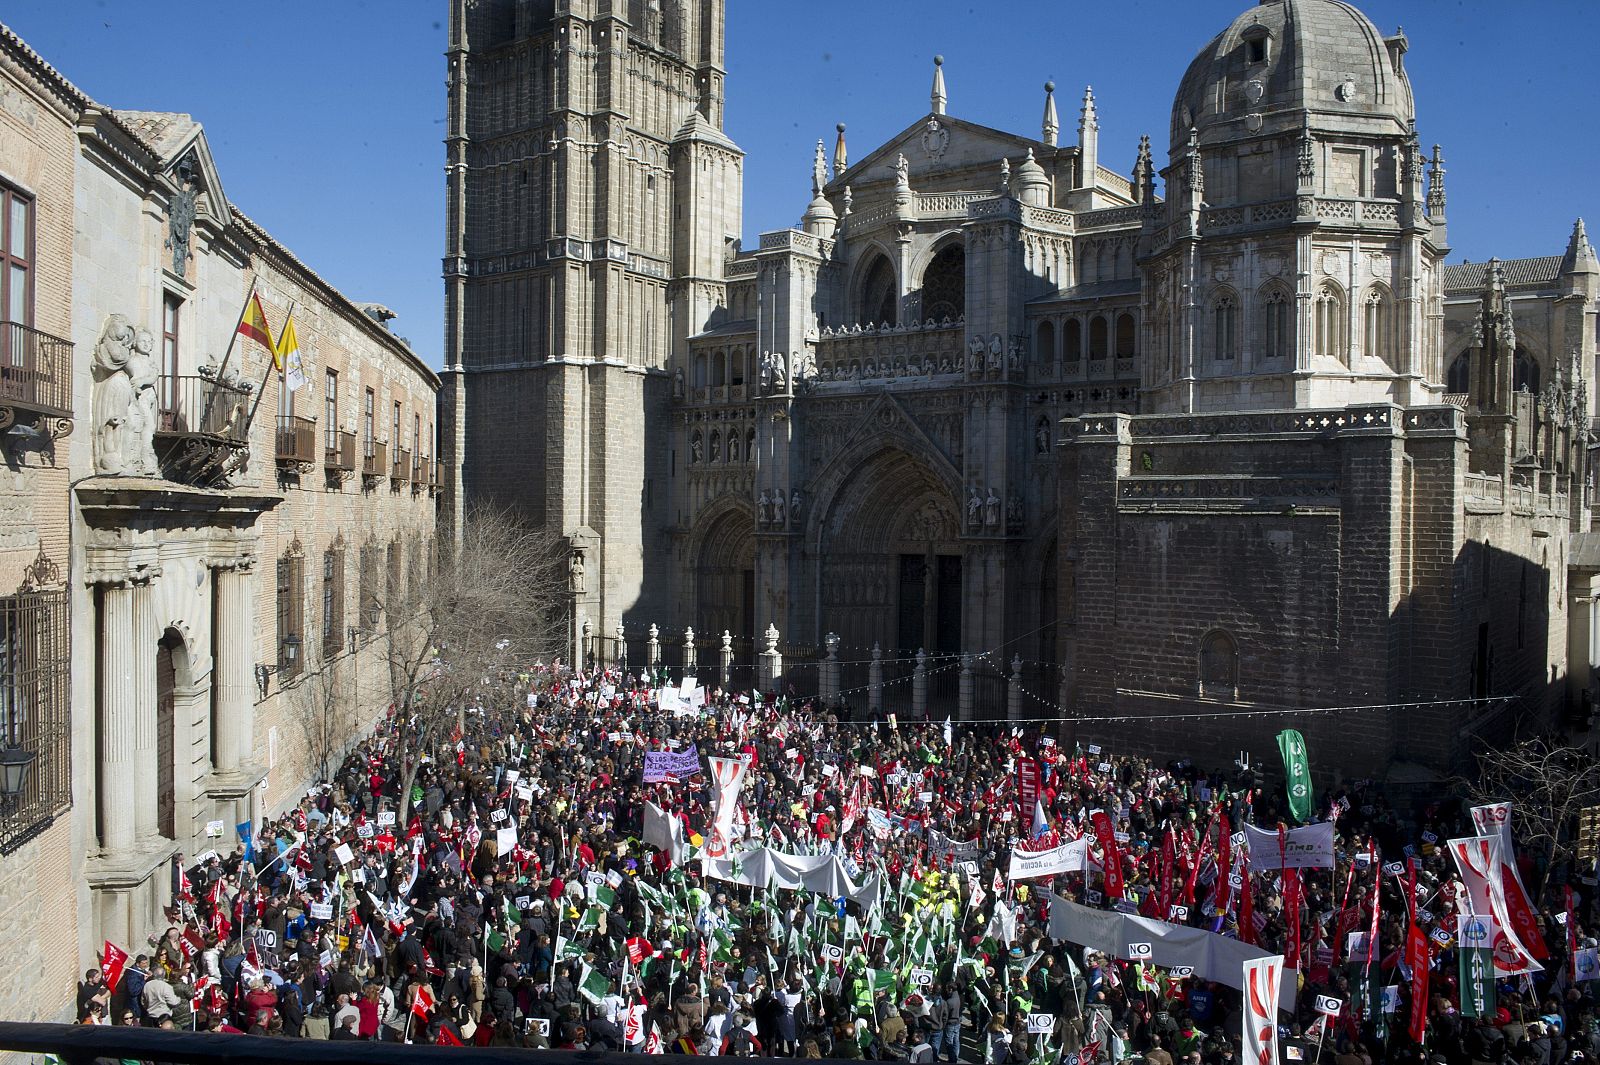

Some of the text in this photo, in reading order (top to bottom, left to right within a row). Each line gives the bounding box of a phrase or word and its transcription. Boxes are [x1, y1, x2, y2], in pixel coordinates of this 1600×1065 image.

[888, 775, 899, 783] NO
[911, 774, 922, 783] NO
[380, 813, 394, 821] NO
[492, 810, 506, 820] NO
[1231, 834, 1244, 844] NO
[960, 863, 975, 873] NO
[1106, 840, 1116, 887] FSP
[1385, 863, 1402, 873] NO
[1171, 906, 1186, 916] NO
[260, 930, 275, 947] NO
[1434, 929, 1449, 940] NO
[1130, 944, 1150, 954] NO
[266, 951, 278, 968] NO
[1171, 967, 1191, 975] NO
[912, 974, 931, 984] NO
[1317, 996, 1339, 1010] NO
[1028, 1015, 1051, 1027] NO
